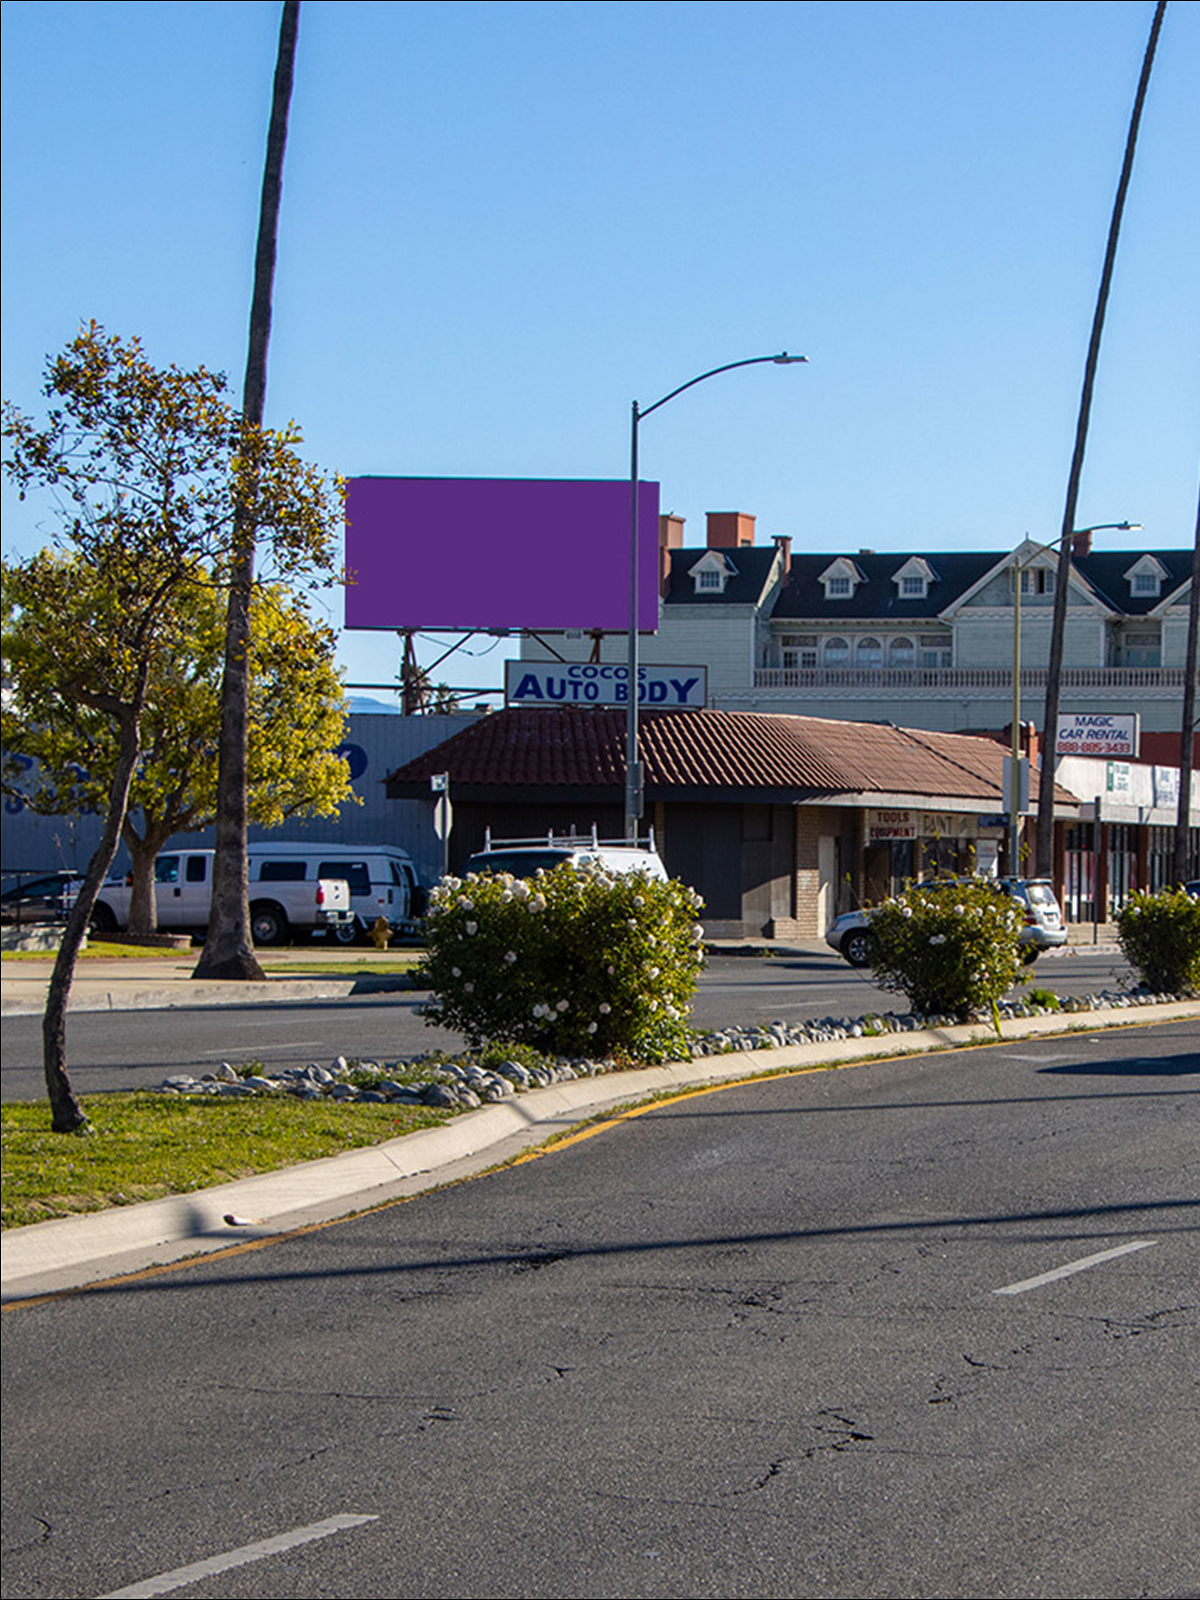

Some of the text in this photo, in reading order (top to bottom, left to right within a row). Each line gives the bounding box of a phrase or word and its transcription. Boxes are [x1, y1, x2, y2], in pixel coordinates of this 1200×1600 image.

[567, 665, 647, 680] COCOS
[513, 674, 699, 703] AUTO BODY
[1075, 716, 1114, 727] MAGIC
[1059, 728, 1129, 740] CAR RENTAL
[877, 811, 910, 823] TOOLS
